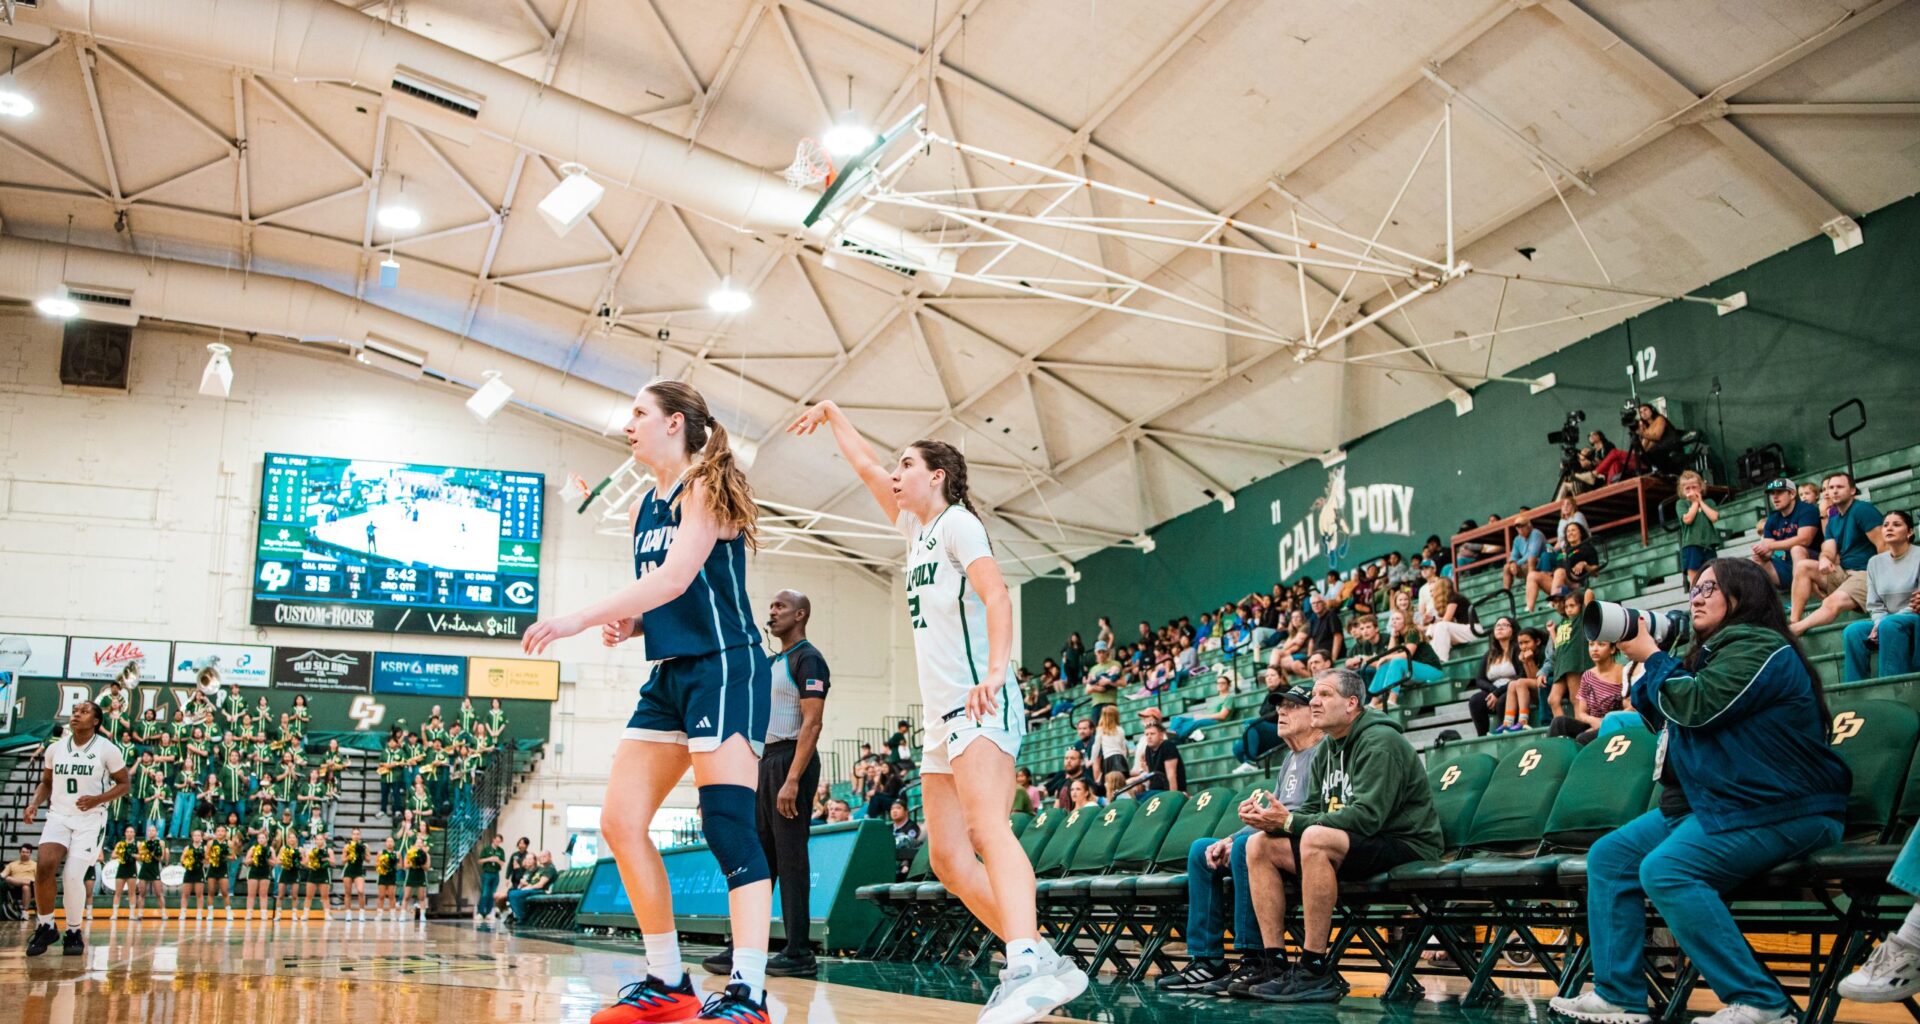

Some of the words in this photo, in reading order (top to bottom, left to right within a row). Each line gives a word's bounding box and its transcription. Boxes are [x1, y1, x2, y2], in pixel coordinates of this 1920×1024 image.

[1635, 345, 1658, 382] 12
[273, 456, 287, 465] CAL
[1270, 499, 1281, 525] 11
[1279, 513, 1320, 581] CAL
[1348, 483, 1414, 538] POLY
[386, 567, 417, 582] 5:42
[304, 575, 331, 592] 35
[399, 583, 416, 594] QTR
[466, 585, 493, 602] 42
[94, 642, 144, 666] Villa
[293, 661, 312, 672] OLD
[312, 661, 330, 671] SLO
[381, 661, 410, 672] KSBY
[410, 660, 423, 674] 6
[426, 663, 459, 676] NEWS
[1603, 734, 1631, 762] CP
[54, 763, 70, 775] CAL
[71, 763, 95, 776] POLY
[1517, 748, 1543, 777] CP
[66, 778, 78, 794] 0
[1439, 764, 1462, 791] CP
